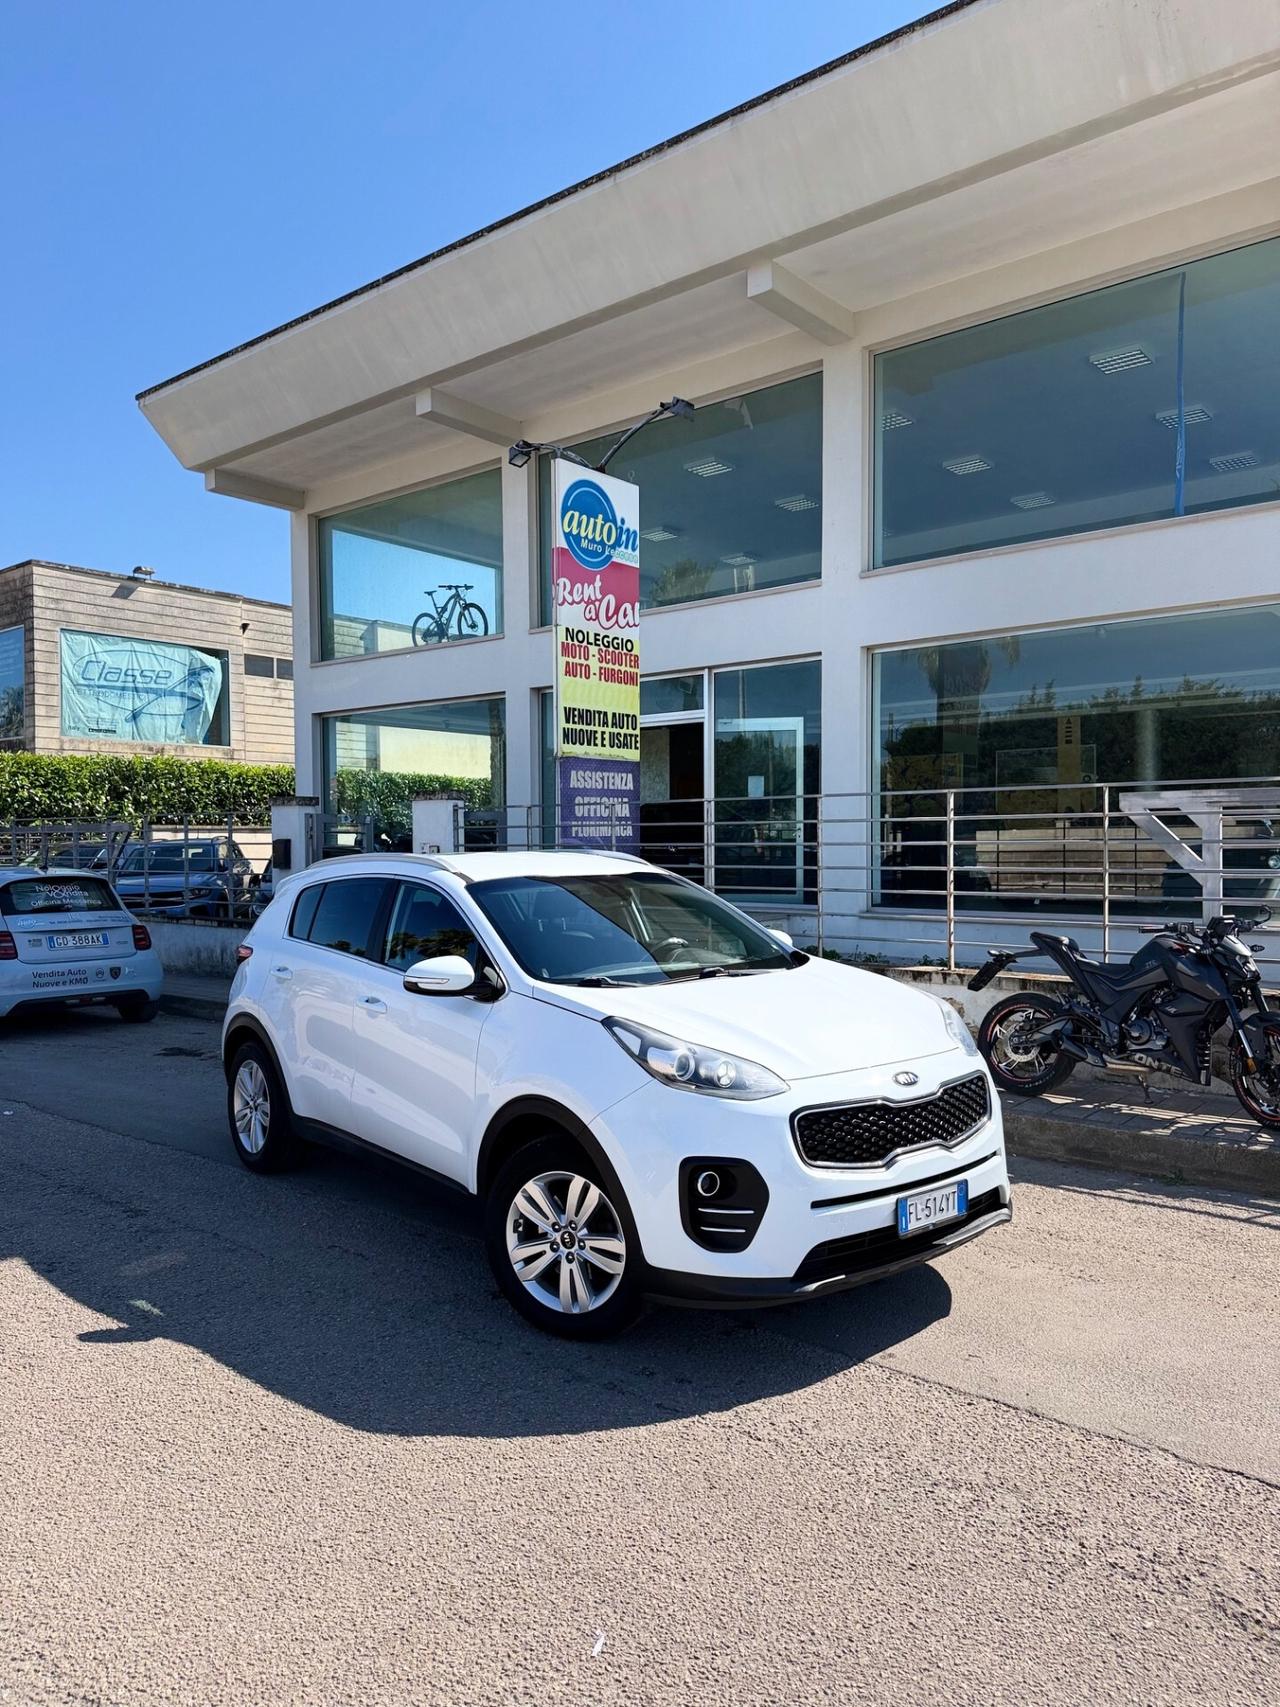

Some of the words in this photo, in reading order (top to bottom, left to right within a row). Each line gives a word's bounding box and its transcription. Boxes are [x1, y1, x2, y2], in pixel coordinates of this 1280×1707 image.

[580, 538, 602, 553] Muro
[557, 575, 602, 605] Rent
[565, 627, 634, 652] NOLEGGIO
[561, 641, 590, 661] MOTO
[597, 648, 639, 669] SCOOTER
[81, 660, 172, 685] Classe
[564, 661, 590, 680] AUTO
[599, 667, 638, 686] FURGONI
[564, 706, 609, 728] VENDITA
[611, 712, 637, 730] AUTO
[562, 727, 598, 747] NUOVE
[600, 730, 606, 748] E
[608, 731, 639, 750] USATE
[570, 770, 634, 790] ASSISTENZA
[574, 796, 630, 817] OFFICINA
[32, 970, 65, 979] Vendita
[67, 968, 87, 976] Auto
[32, 980, 61, 988] Nuove
